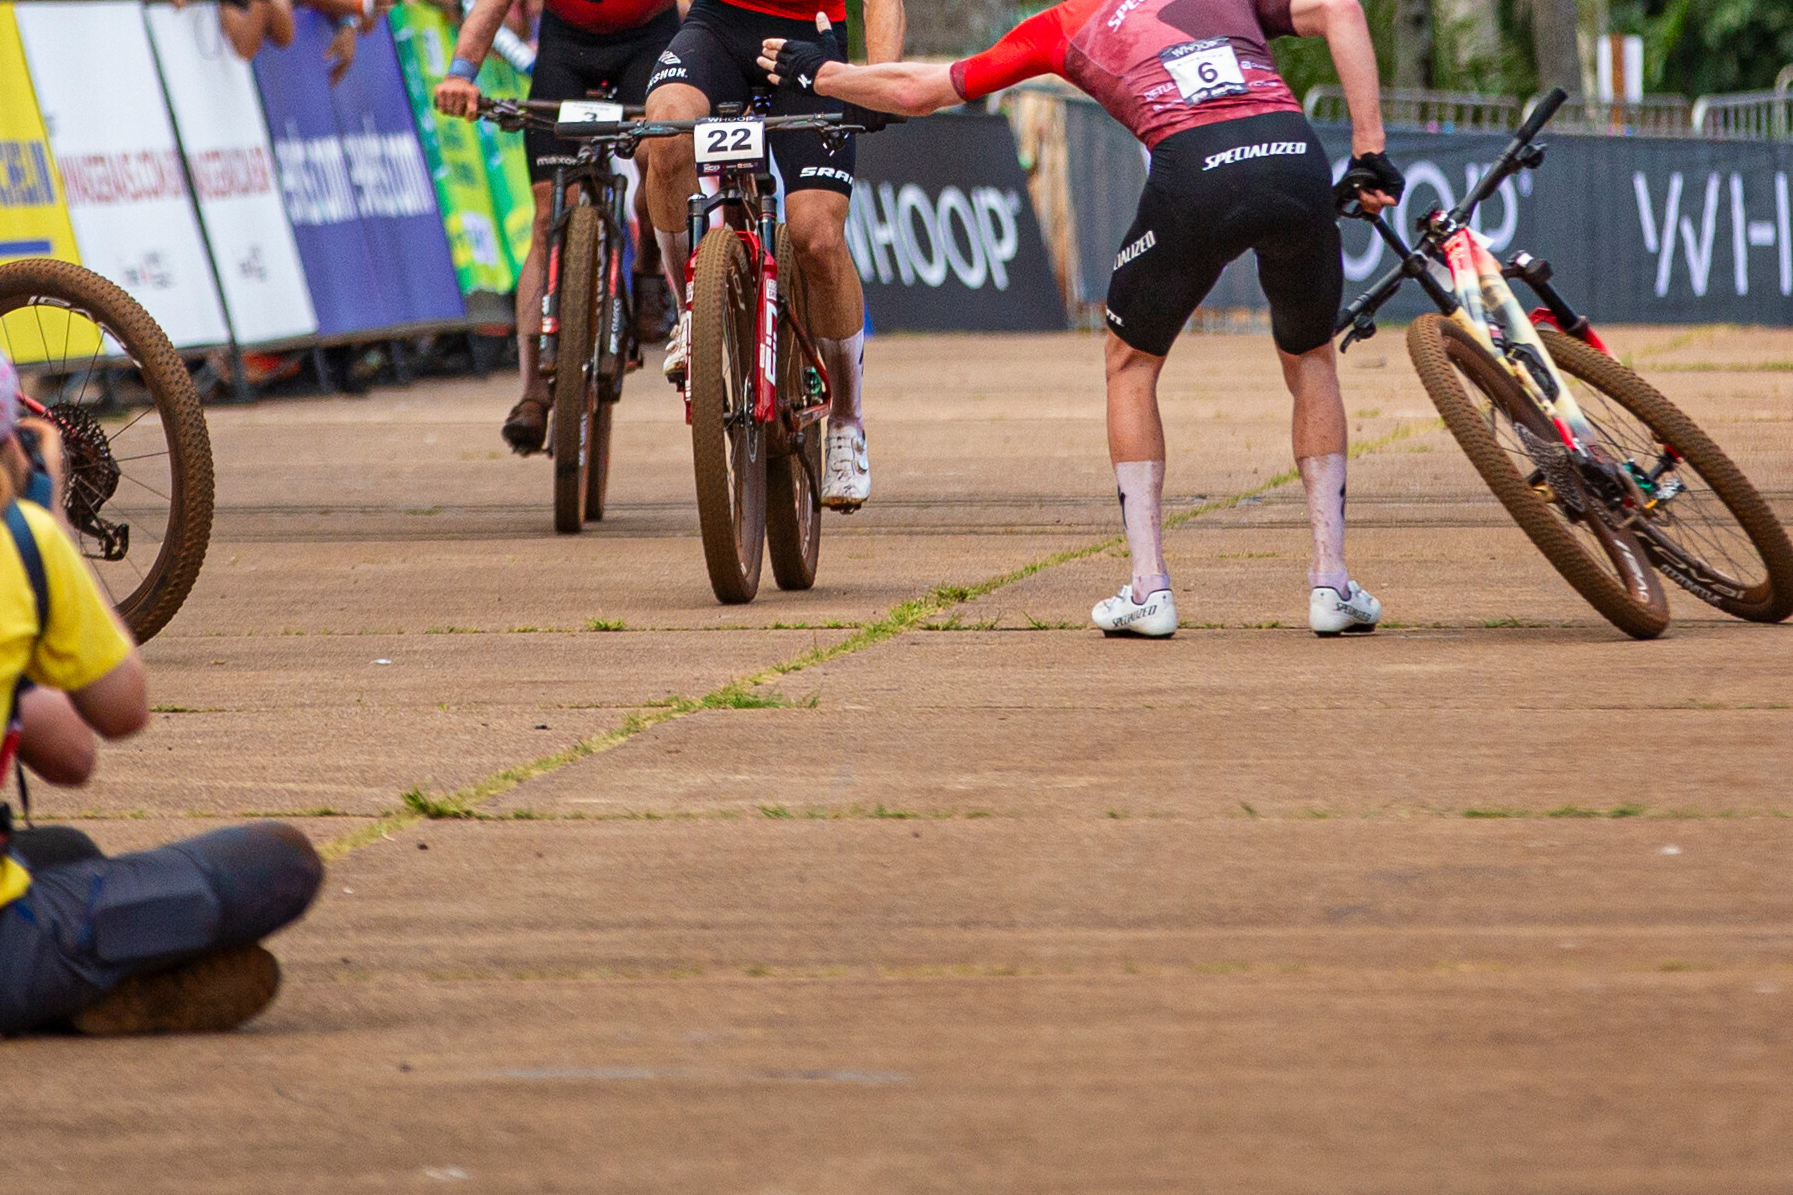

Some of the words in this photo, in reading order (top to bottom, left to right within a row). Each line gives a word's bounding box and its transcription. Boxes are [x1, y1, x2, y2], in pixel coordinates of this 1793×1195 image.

[1197, 61, 1219, 84] 6
[707, 128, 752, 154] 22
[1202, 141, 1307, 172] SPECIALIZED
